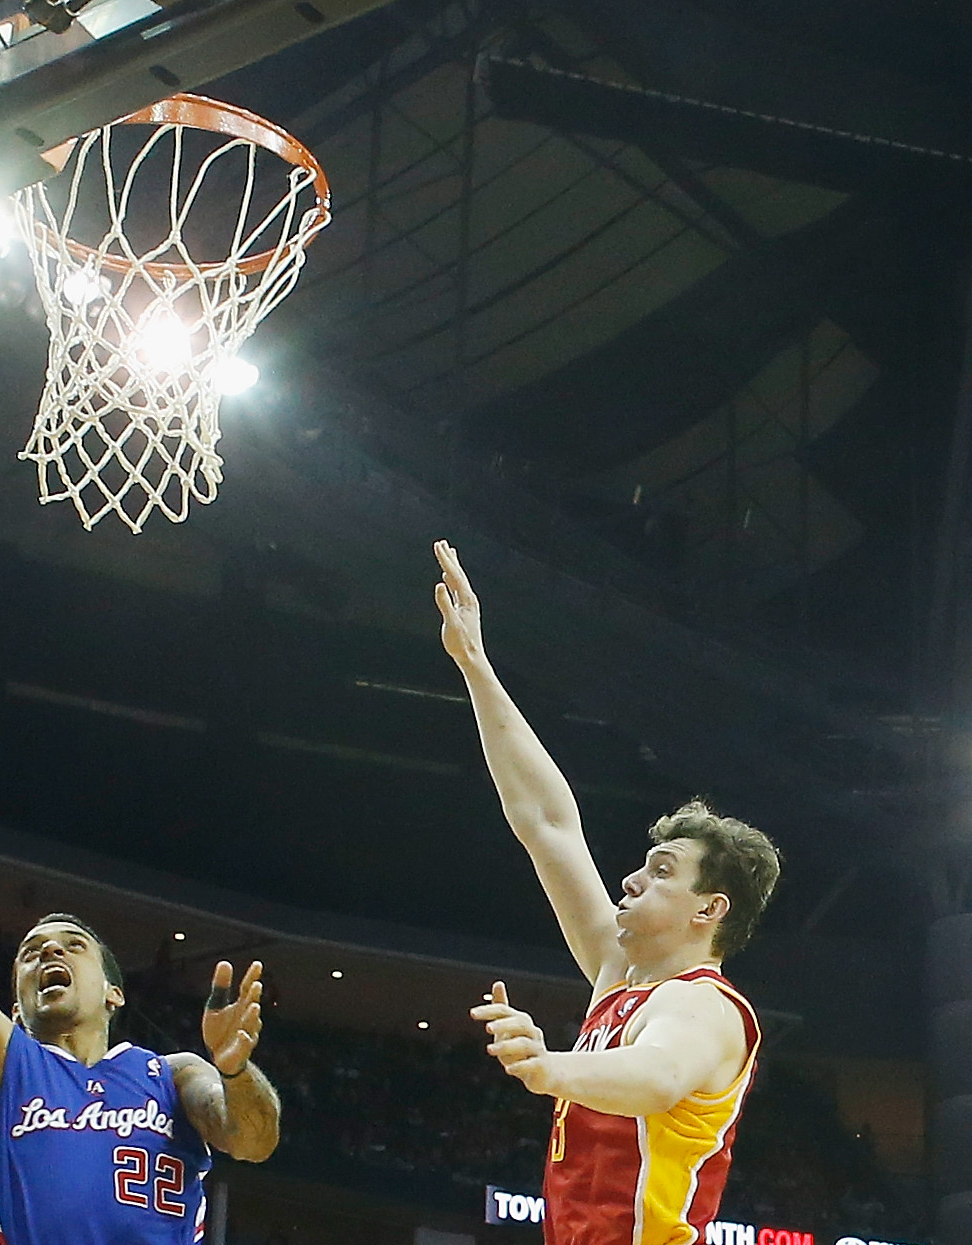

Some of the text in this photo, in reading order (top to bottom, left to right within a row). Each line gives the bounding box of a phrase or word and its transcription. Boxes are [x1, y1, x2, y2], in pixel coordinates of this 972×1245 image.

[12, 1098, 70, 1138] Los
[113, 1146, 186, 1218] 22
[494, 1191, 546, 1224] TOY
